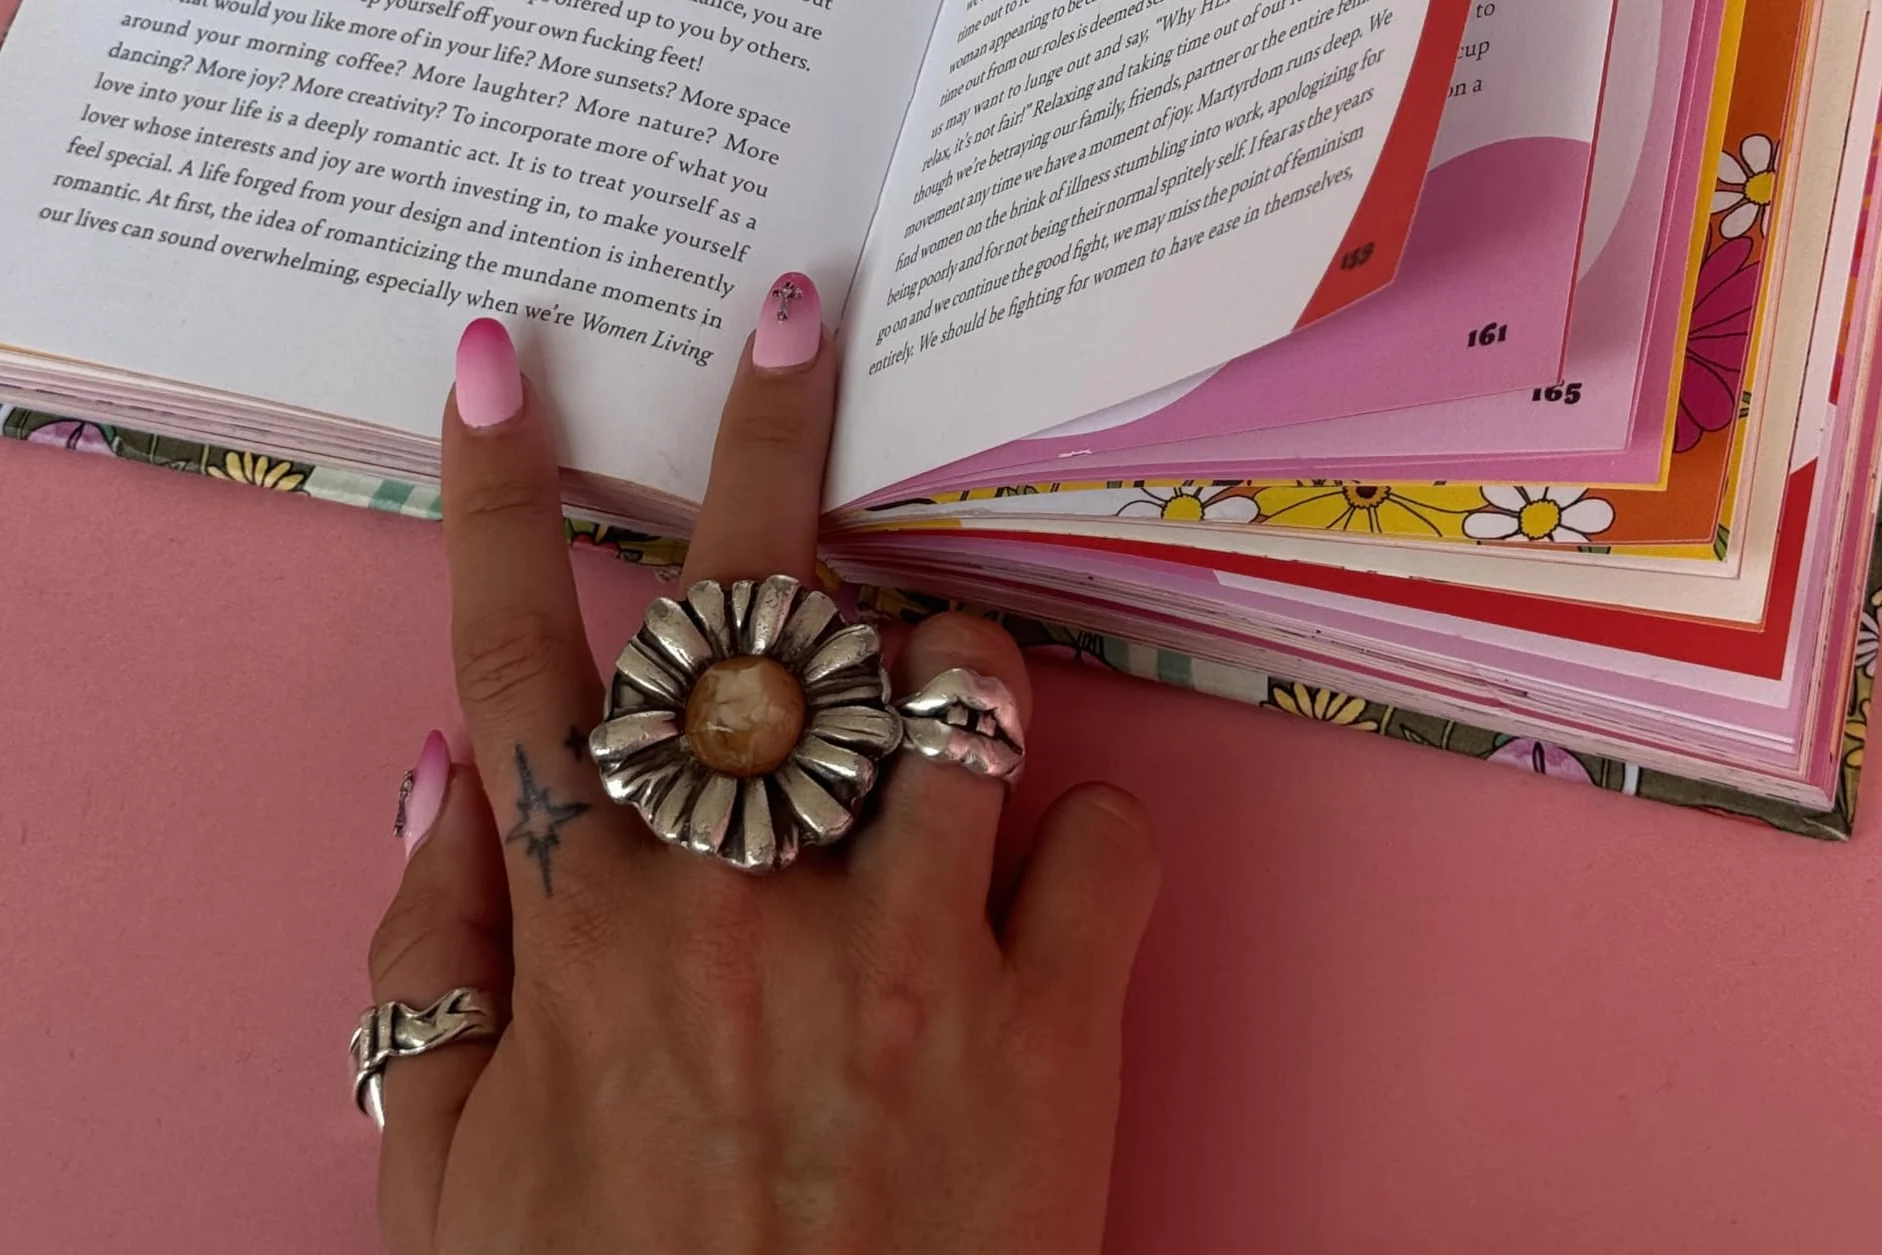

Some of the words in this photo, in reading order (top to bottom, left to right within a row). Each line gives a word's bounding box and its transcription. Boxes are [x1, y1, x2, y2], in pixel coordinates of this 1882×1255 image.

[108, 41, 194, 74] dancing?
[195, 58, 246, 82] More
[247, 68, 290, 92] joy?
[291, 75, 343, 99] More
[347, 91, 447, 121] creativity?
[453, 105, 475, 125] To
[479, 112, 591, 149] incorporate
[595, 141, 647, 161] more
[652, 151, 678, 168] of
[679, 159, 727, 184] what
[730, 176, 768, 198] you
[121, 15, 191, 37] around
[194, 28, 241, 46] your
[246, 38, 330, 67] morning
[336, 52, 407, 76] coffee?
[412, 63, 465, 88] More
[473, 73, 569, 108] laughter?
[574, 95, 630, 122] More
[637, 116, 717, 144] nature?
[723, 133, 779, 165] More
[895, 244, 920, 272] find
[922, 230, 963, 258] women
[966, 222, 982, 237] on
[986, 209, 1007, 229] the
[1010, 190, 1046, 219] brink
[1049, 180, 1067, 203] of
[1066, 169, 1111, 197] illness
[1113, 138, 1188, 178] stumbling
[1190, 125, 1220, 147] into
[1225, 102, 1263, 132] work,
[1268, 61, 1358, 115] apologizing
[1360, 48, 1385, 70] for
[931, 123, 943, 139] us
[945, 108, 970, 130] may
[974, 91, 1004, 115] want
[1008, 85, 1021, 99] to
[1024, 66, 1063, 91] lunge
[1067, 53, 1091, 73] out
[1094, 34, 1123, 61] and
[1125, 29, 1149, 48] say,
[39, 208, 74, 223] our
[75, 208, 118, 233] lives
[121, 224, 154, 240] can
[158, 231, 219, 252] sound
[221, 243, 359, 285] overwhelming,
[366, 272, 462, 307] especially
[467, 290, 518, 315] when
[525, 304, 574, 326] we're
[583, 312, 647, 343] Women
[651, 330, 714, 367] Living
[53, 175, 141, 202] romantic.
[146, 189, 171, 207] At
[174, 192, 214, 219] first,
[221, 202, 252, 223] the
[256, 209, 296, 232] idea
[301, 218, 327, 236] of
[325, 228, 462, 270] romanticizing
[466, 251, 497, 272] the
[501, 264, 597, 294] mundane
[601, 286, 698, 320] moments
[701, 308, 722, 329] in
[66, 136, 104, 158] feel
[105, 150, 172, 172] special.
[177, 160, 192, 176] A
[198, 161, 230, 183] life
[234, 168, 297, 196] forged
[299, 180, 345, 206] from
[349, 197, 396, 215] your
[400, 201, 461, 232] design
[467, 220, 506, 238] and
[509, 224, 601, 259] intention
[606, 245, 623, 263] is
[627, 251, 735, 299] inherently
[869, 342, 914, 375] entirely.
[920, 331, 938, 352] We
[941, 309, 986, 343] should
[989, 305, 1005, 324] be
[1008, 285, 1065, 319] fighting
[1067, 274, 1090, 294] for
[1094, 255, 1146, 284] women
[1151, 248, 1165, 263] to
[1169, 232, 1205, 256] have
[1209, 216, 1240, 239] ease
[1244, 206, 1259, 224] in
[1264, 166, 1353, 215] themselves,
[1467, 322, 1508, 348] 161
[1531, 380, 1583, 405] 165
